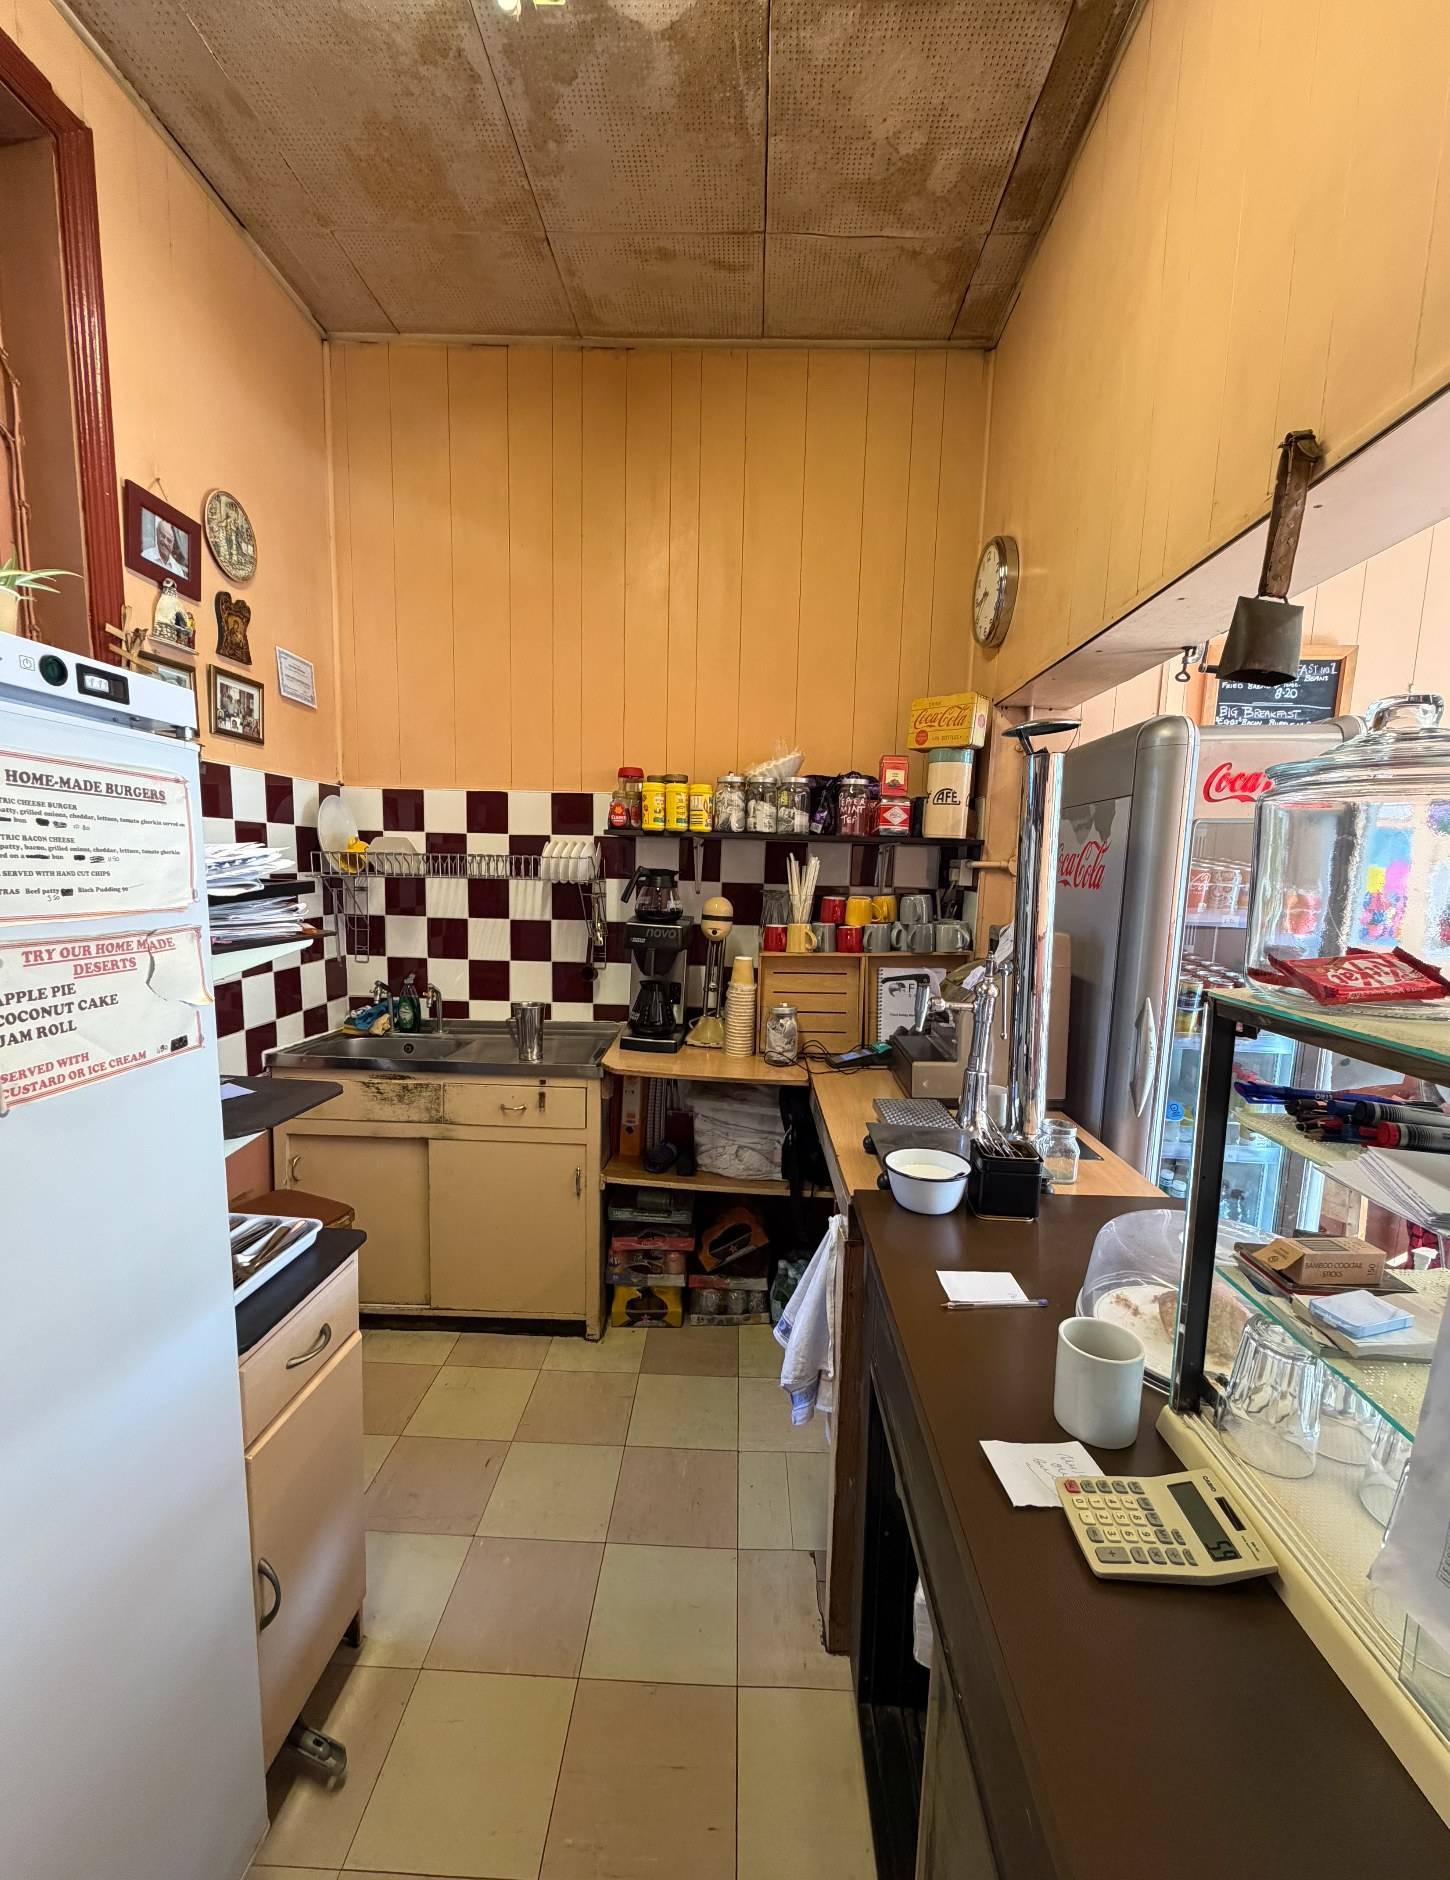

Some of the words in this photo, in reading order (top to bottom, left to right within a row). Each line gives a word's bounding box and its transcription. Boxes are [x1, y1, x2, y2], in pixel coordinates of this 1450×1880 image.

[914, 705, 970, 729] Coca-Cola
[1219, 706, 1239, 718] BIG
[1242, 706, 1302, 719] BREAKFAST
[5, 768, 103, 793] HOME-MADE
[105, 783, 166, 801] BURGERS
[17, 798, 47, 807] CHEESE
[47, 801, 78, 811] BURGER
[839, 805, 867, 814] MINT
[48, 836, 75, 844] CHEESE
[646, 928, 677, 938] novo
[21, 948, 57, 963] TRY
[60, 944, 93, 959] OUR
[95, 940, 134, 956] HOME
[136, 936, 176, 951] MADE
[73, 956, 137, 976] DESERTS
[51, 982, 77, 998] PIE
[77, 993, 119, 1011] CAKE
[0, 1028, 33, 1048] JAM
[36, 1020, 77, 1039] ROLL
[0, 1062, 55, 1084] SERVED
[56, 1052, 90, 1070] WITH
[2, 1075, 67, 1099] CUSTARD
[68, 1069, 86, 1081] OR
[88, 1062, 106, 1076] ICE
[109, 1050, 147, 1069] CREAM
[1366, 1263, 1377, 1277] 150
[1202, 1475, 1217, 1492] CASIO
